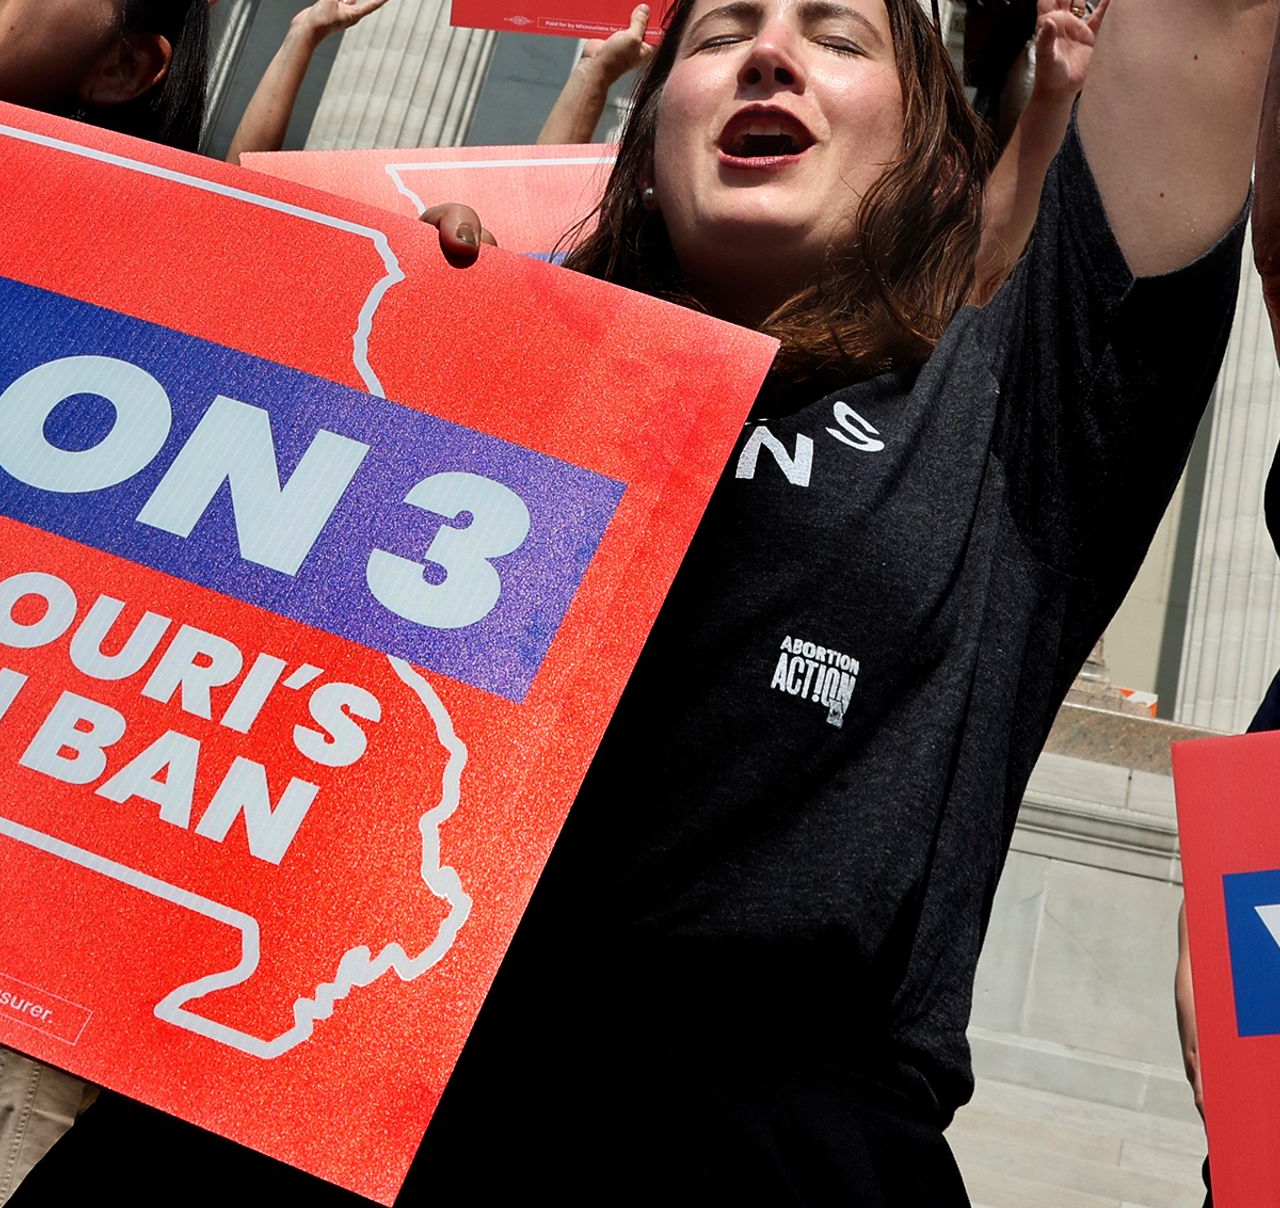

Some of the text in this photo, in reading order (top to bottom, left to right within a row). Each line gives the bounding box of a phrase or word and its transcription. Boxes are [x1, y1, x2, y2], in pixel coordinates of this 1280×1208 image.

[366, 471, 535, 631] 3
[779, 635, 860, 675] ABORTION
[18, 691, 322, 864] BAN
